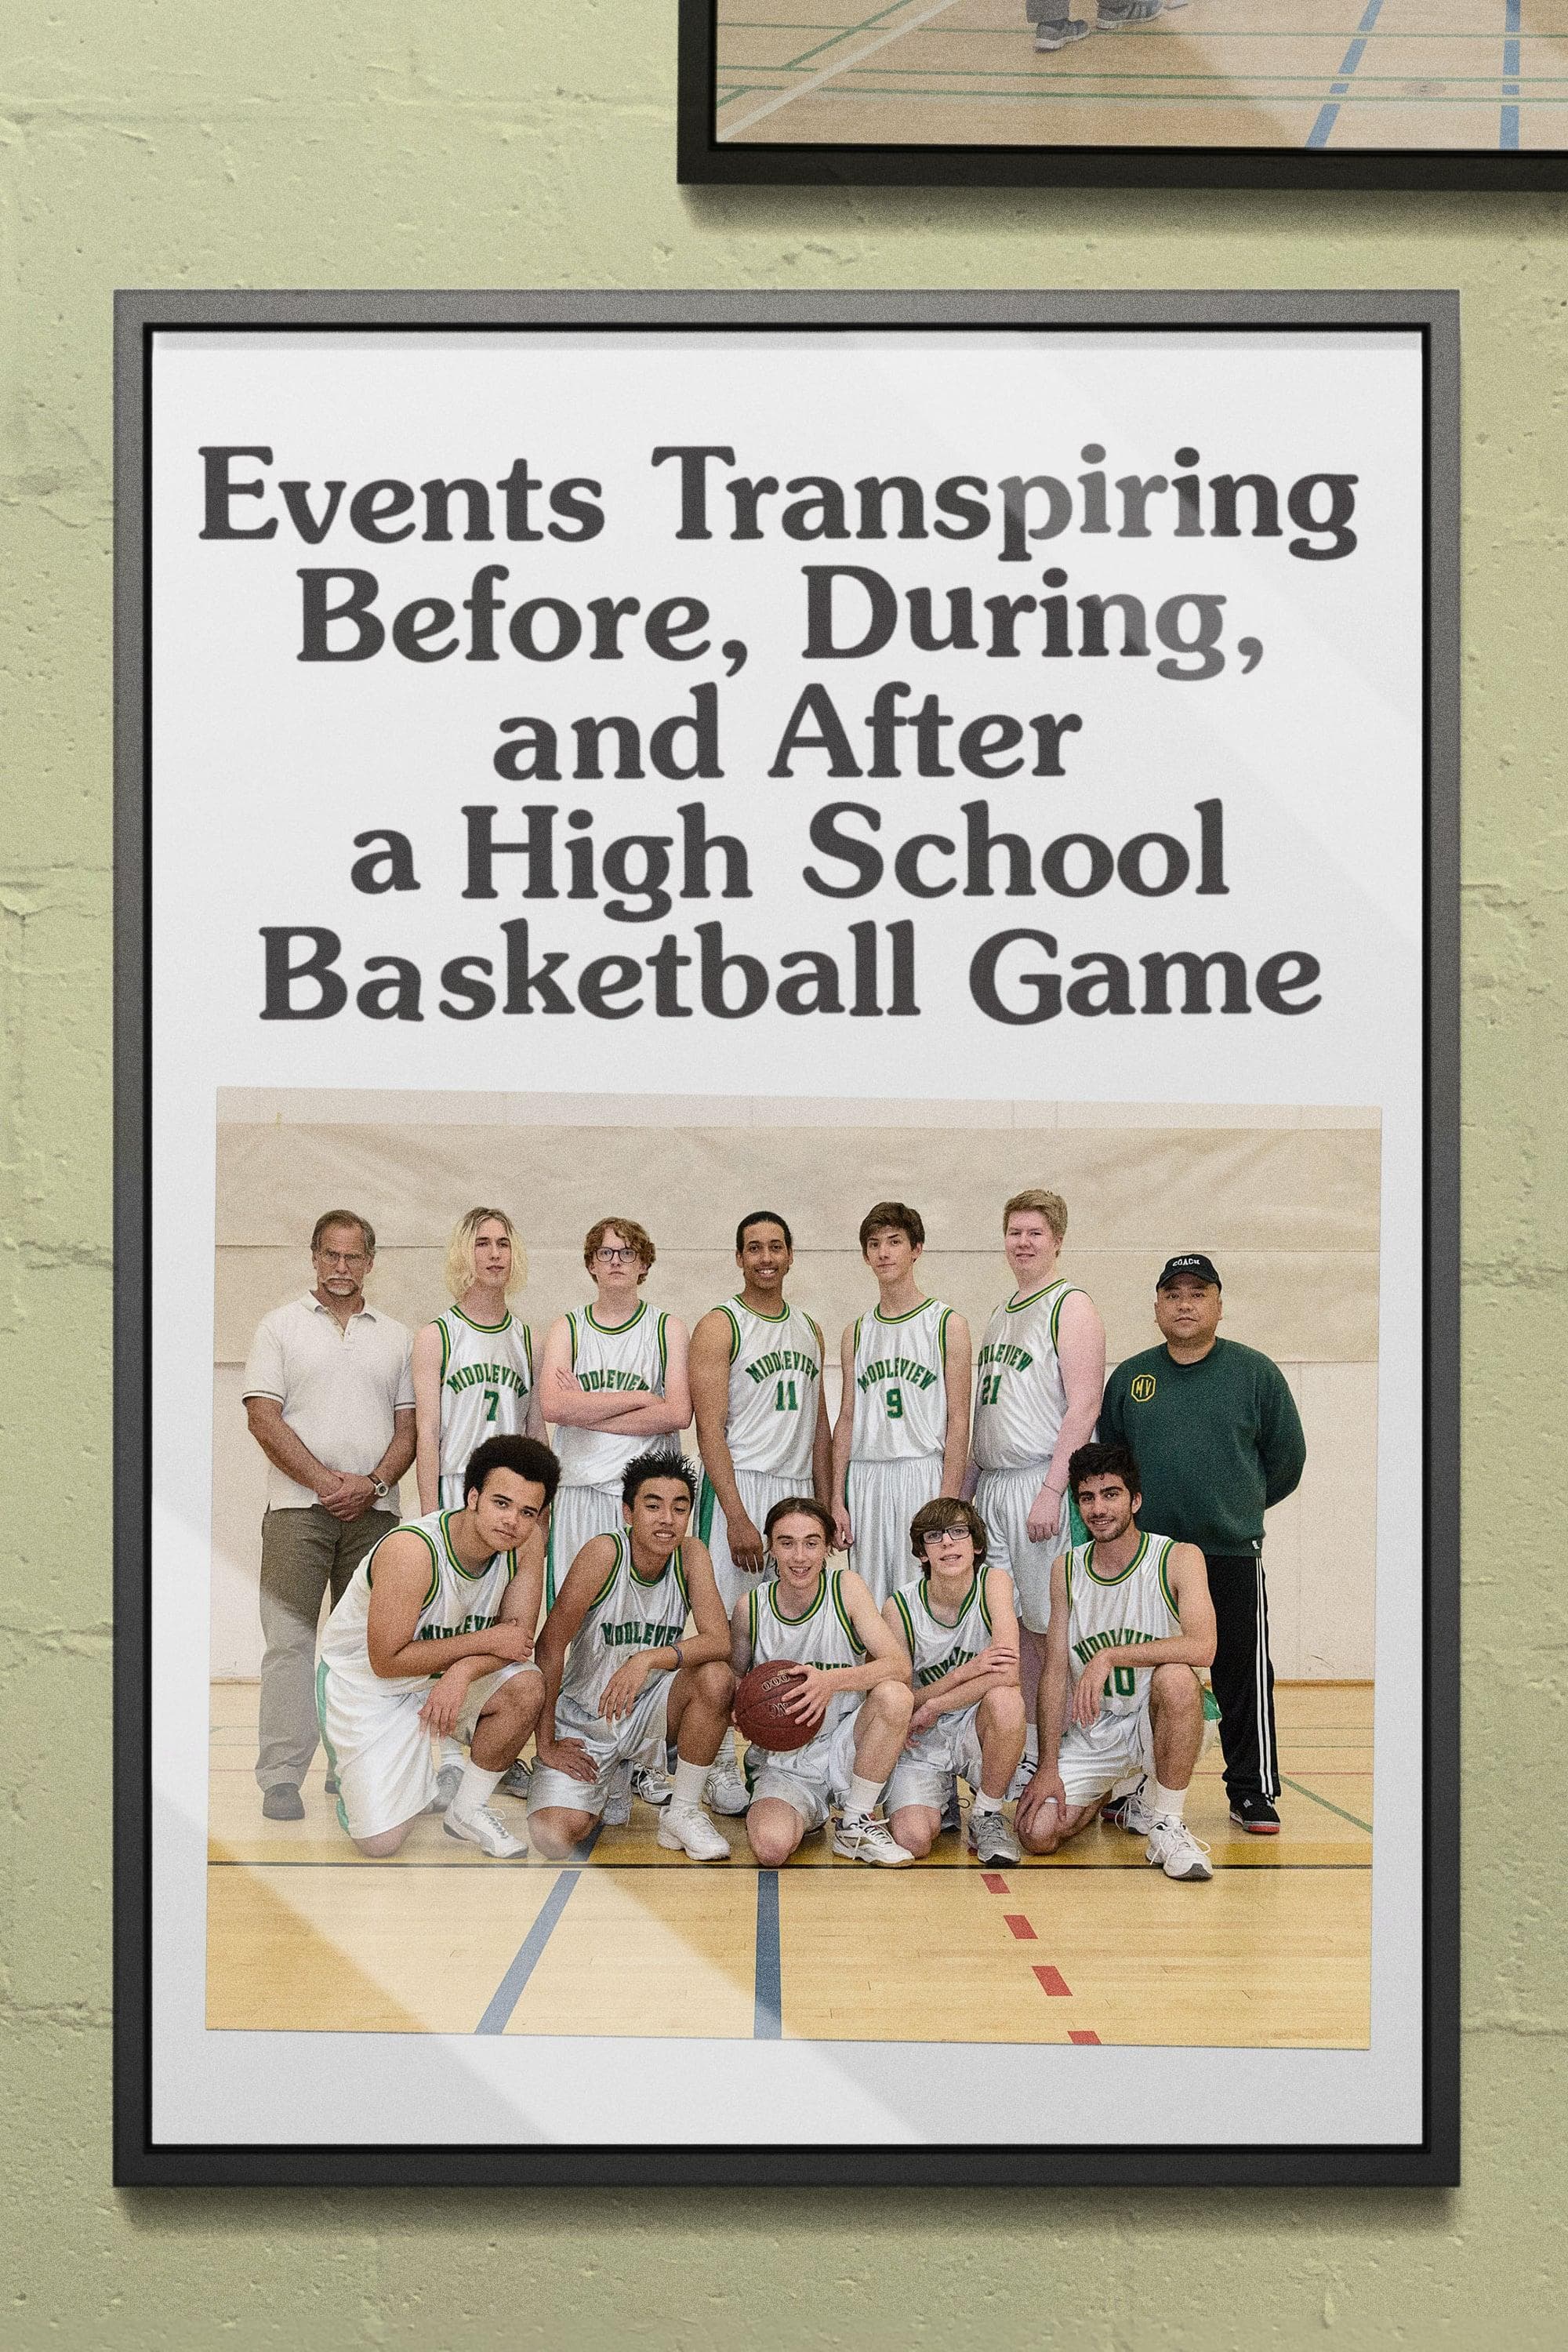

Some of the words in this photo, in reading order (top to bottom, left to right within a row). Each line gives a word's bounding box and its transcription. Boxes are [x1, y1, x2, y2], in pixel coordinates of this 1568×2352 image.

[198, 446, 605, 545] Events
[651, 444, 1359, 562] Transpiring
[296, 564, 749, 678] Before,
[800, 565, 1264, 681] During,
[493, 681, 724, 781] and
[768, 681, 1083, 780] After
[350, 829, 421, 895] a
[461, 801, 753, 924] High
[802, 798, 1230, 899] School
[259, 917, 921, 1022] Basketball
[969, 927, 1323, 1025] Game
[484, 1388, 499, 1421] 7
[775, 1380, 798, 1411] 11
[886, 1388, 903, 1419] 9
[982, 1374, 1003, 1406] 21
